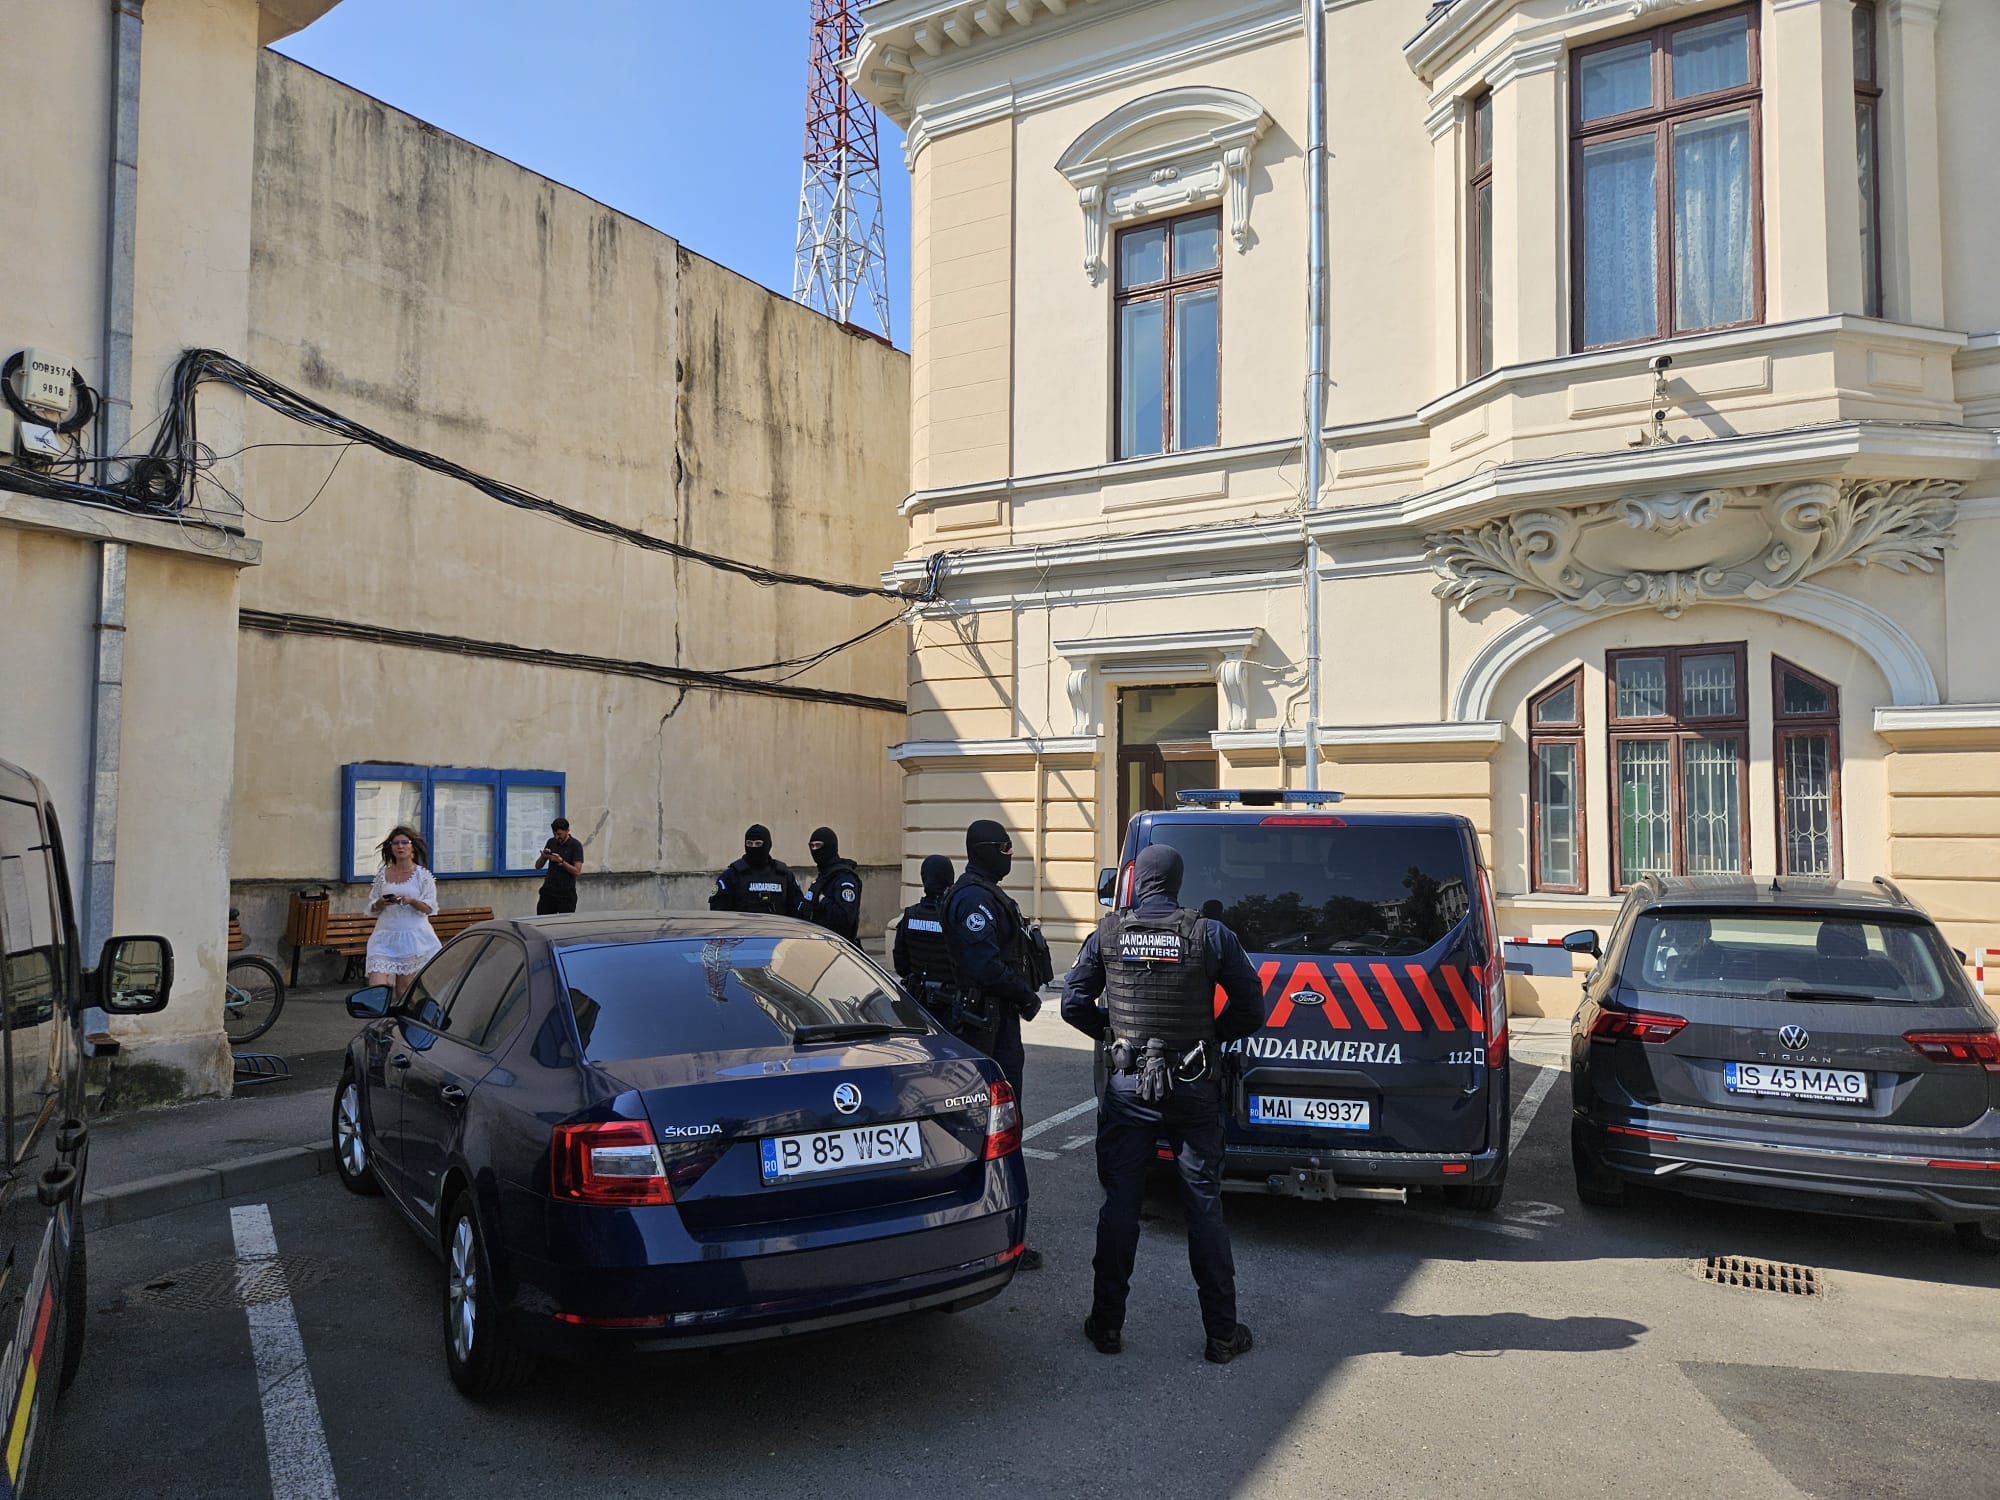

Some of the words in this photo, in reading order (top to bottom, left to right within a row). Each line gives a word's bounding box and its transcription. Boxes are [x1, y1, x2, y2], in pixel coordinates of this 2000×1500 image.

[1120, 934, 1181, 947] JANDARMERIA
[1122, 948, 1179, 957] ANTITERO
[1448, 1051, 1472, 1064] 112
[1758, 1052, 1832, 1064] TIGUAN
[1726, 1076, 1737, 1085] RO
[1739, 1066, 1761, 1086] IS
[1770, 1069, 1797, 1090] 45
[1801, 1071, 1860, 1094] MAG
[945, 1093, 988, 1108] OCTAVIA
[1250, 1108, 1259, 1117] RO
[1262, 1098, 1292, 1119] MAI
[1303, 1101, 1364, 1122] 49937
[665, 1124, 723, 1138] ŠKODA
[764, 1160, 777, 1173] RO
[781, 1139, 802, 1169] B
[812, 1134, 844, 1165] 85
[853, 1126, 913, 1160] WSK
